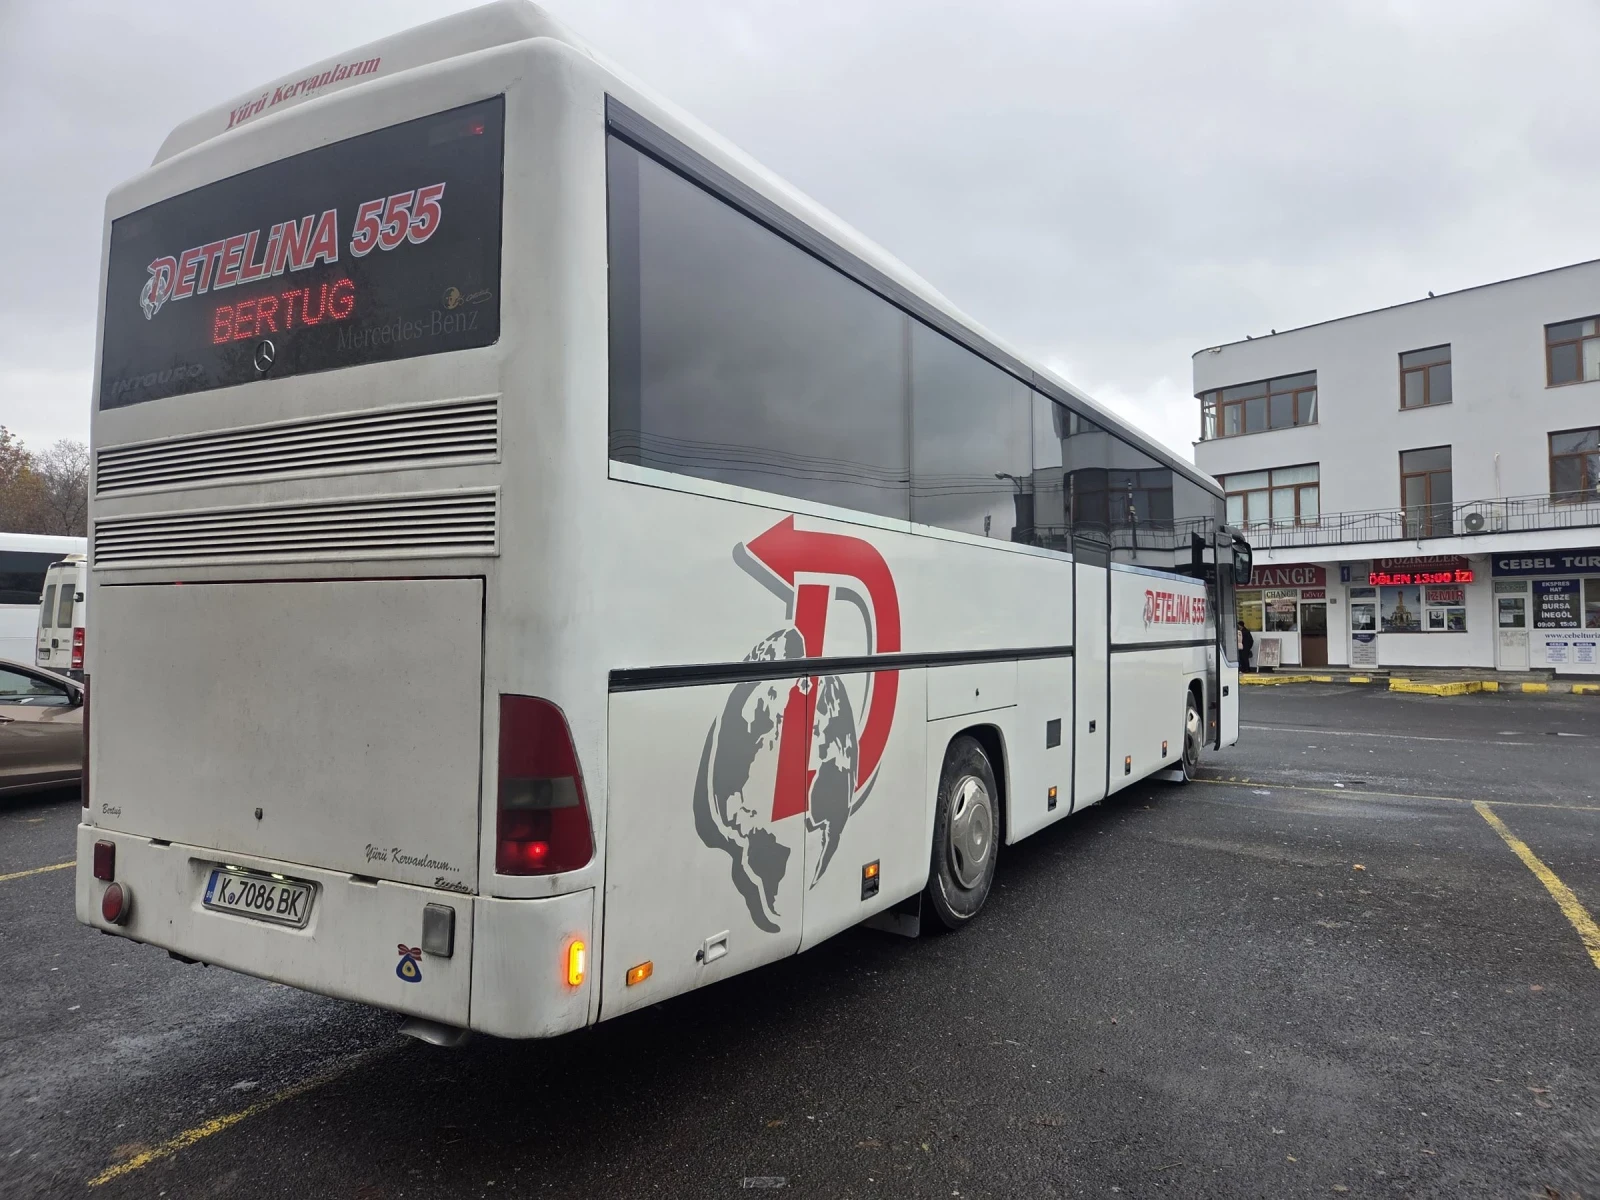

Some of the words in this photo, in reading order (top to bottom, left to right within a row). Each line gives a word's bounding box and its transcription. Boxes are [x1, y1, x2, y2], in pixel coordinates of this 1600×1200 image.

[225, 92, 268, 131] Yürü
[270, 56, 381, 104] Kervanlarım
[350, 182, 446, 258] 555
[213, 278, 355, 344] BERTUG
[338, 310, 479, 350] Mercedes-Benz
[1239, 568, 1316, 587] HANGE
[1499, 558, 1555, 570] CEBEL
[1414, 573, 1452, 585] 13:00
[1266, 590, 1297, 599] CHANGE
[1192, 597, 1205, 626] 555
[365, 843, 388, 863] Yürü
[234, 881, 277, 911] 7086
[276, 888, 304, 917] BK
